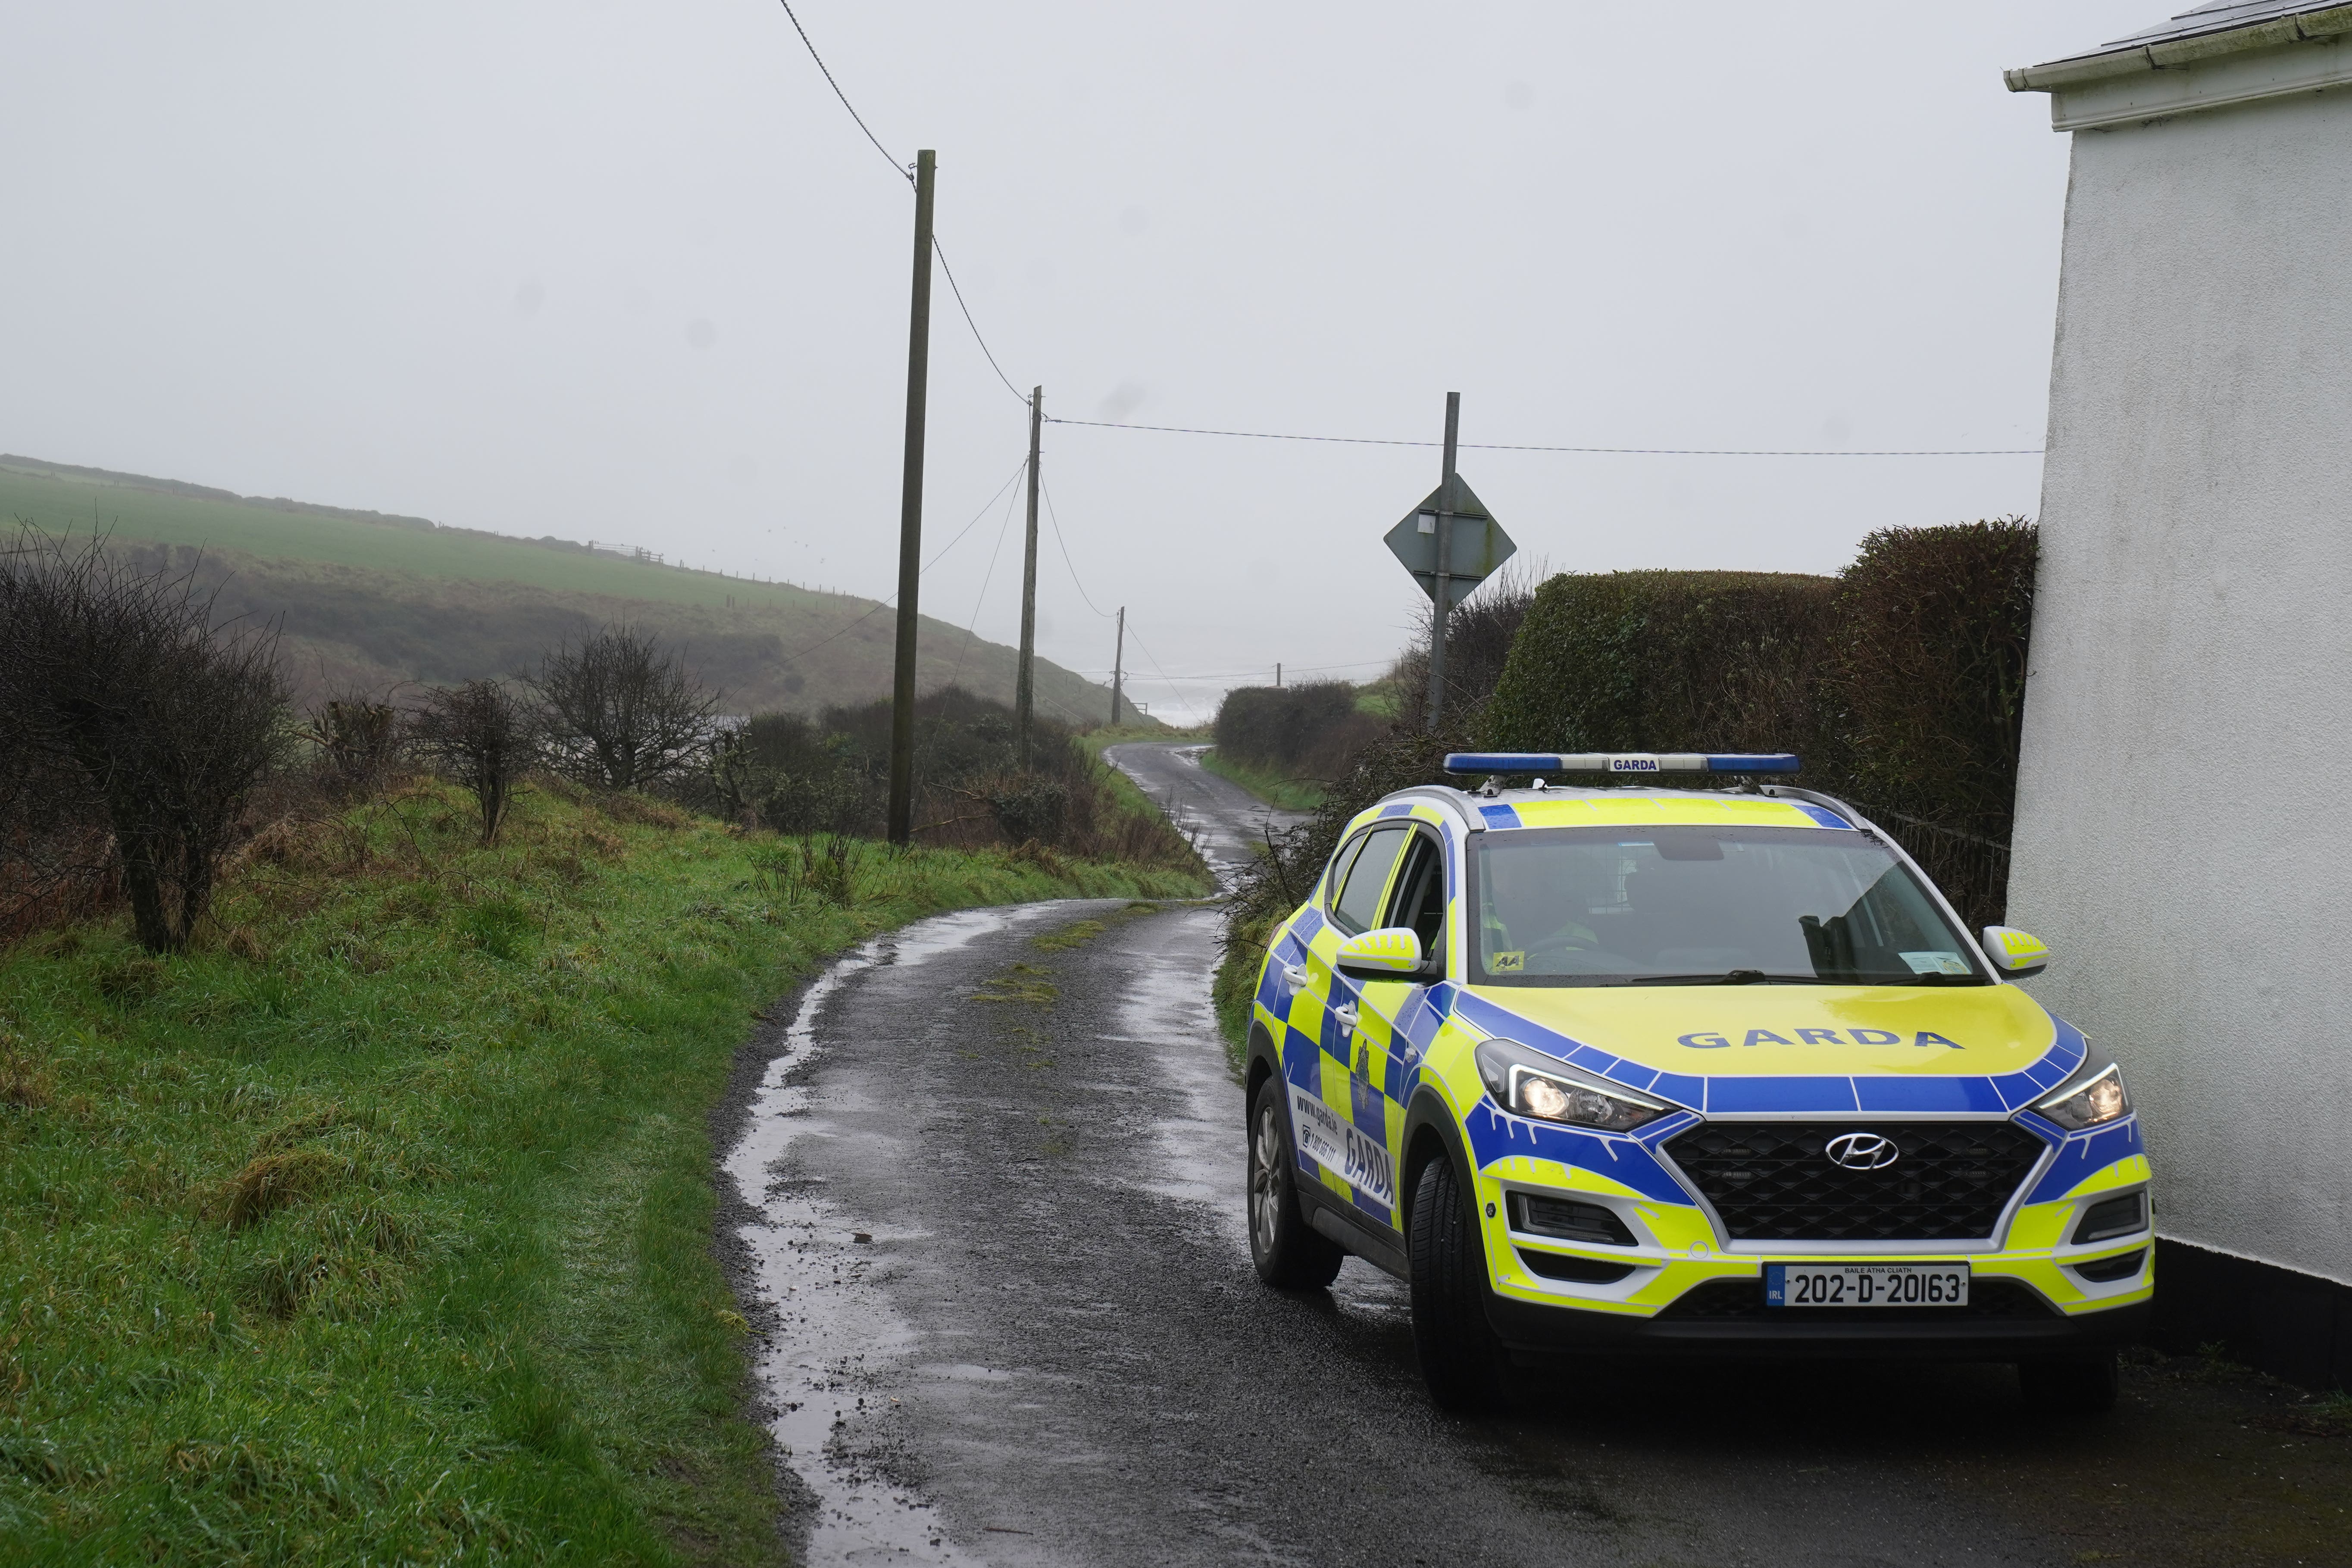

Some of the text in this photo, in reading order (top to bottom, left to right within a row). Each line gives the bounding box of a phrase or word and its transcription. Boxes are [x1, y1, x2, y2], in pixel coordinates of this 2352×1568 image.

[1614, 760, 1657, 770] GARDA
[1496, 955, 1519, 967] AA
[1677, 1028, 1967, 1050] GARDA
[1297, 1095, 1338, 1135] www.garda.ie
[1310, 1133, 1336, 1162] 1 800 666 111
[1345, 1128, 1394, 1205] GARDA
[1769, 1290, 1783, 1299] IRL
[1795, 1274, 1960, 1303] 202-D-20163
